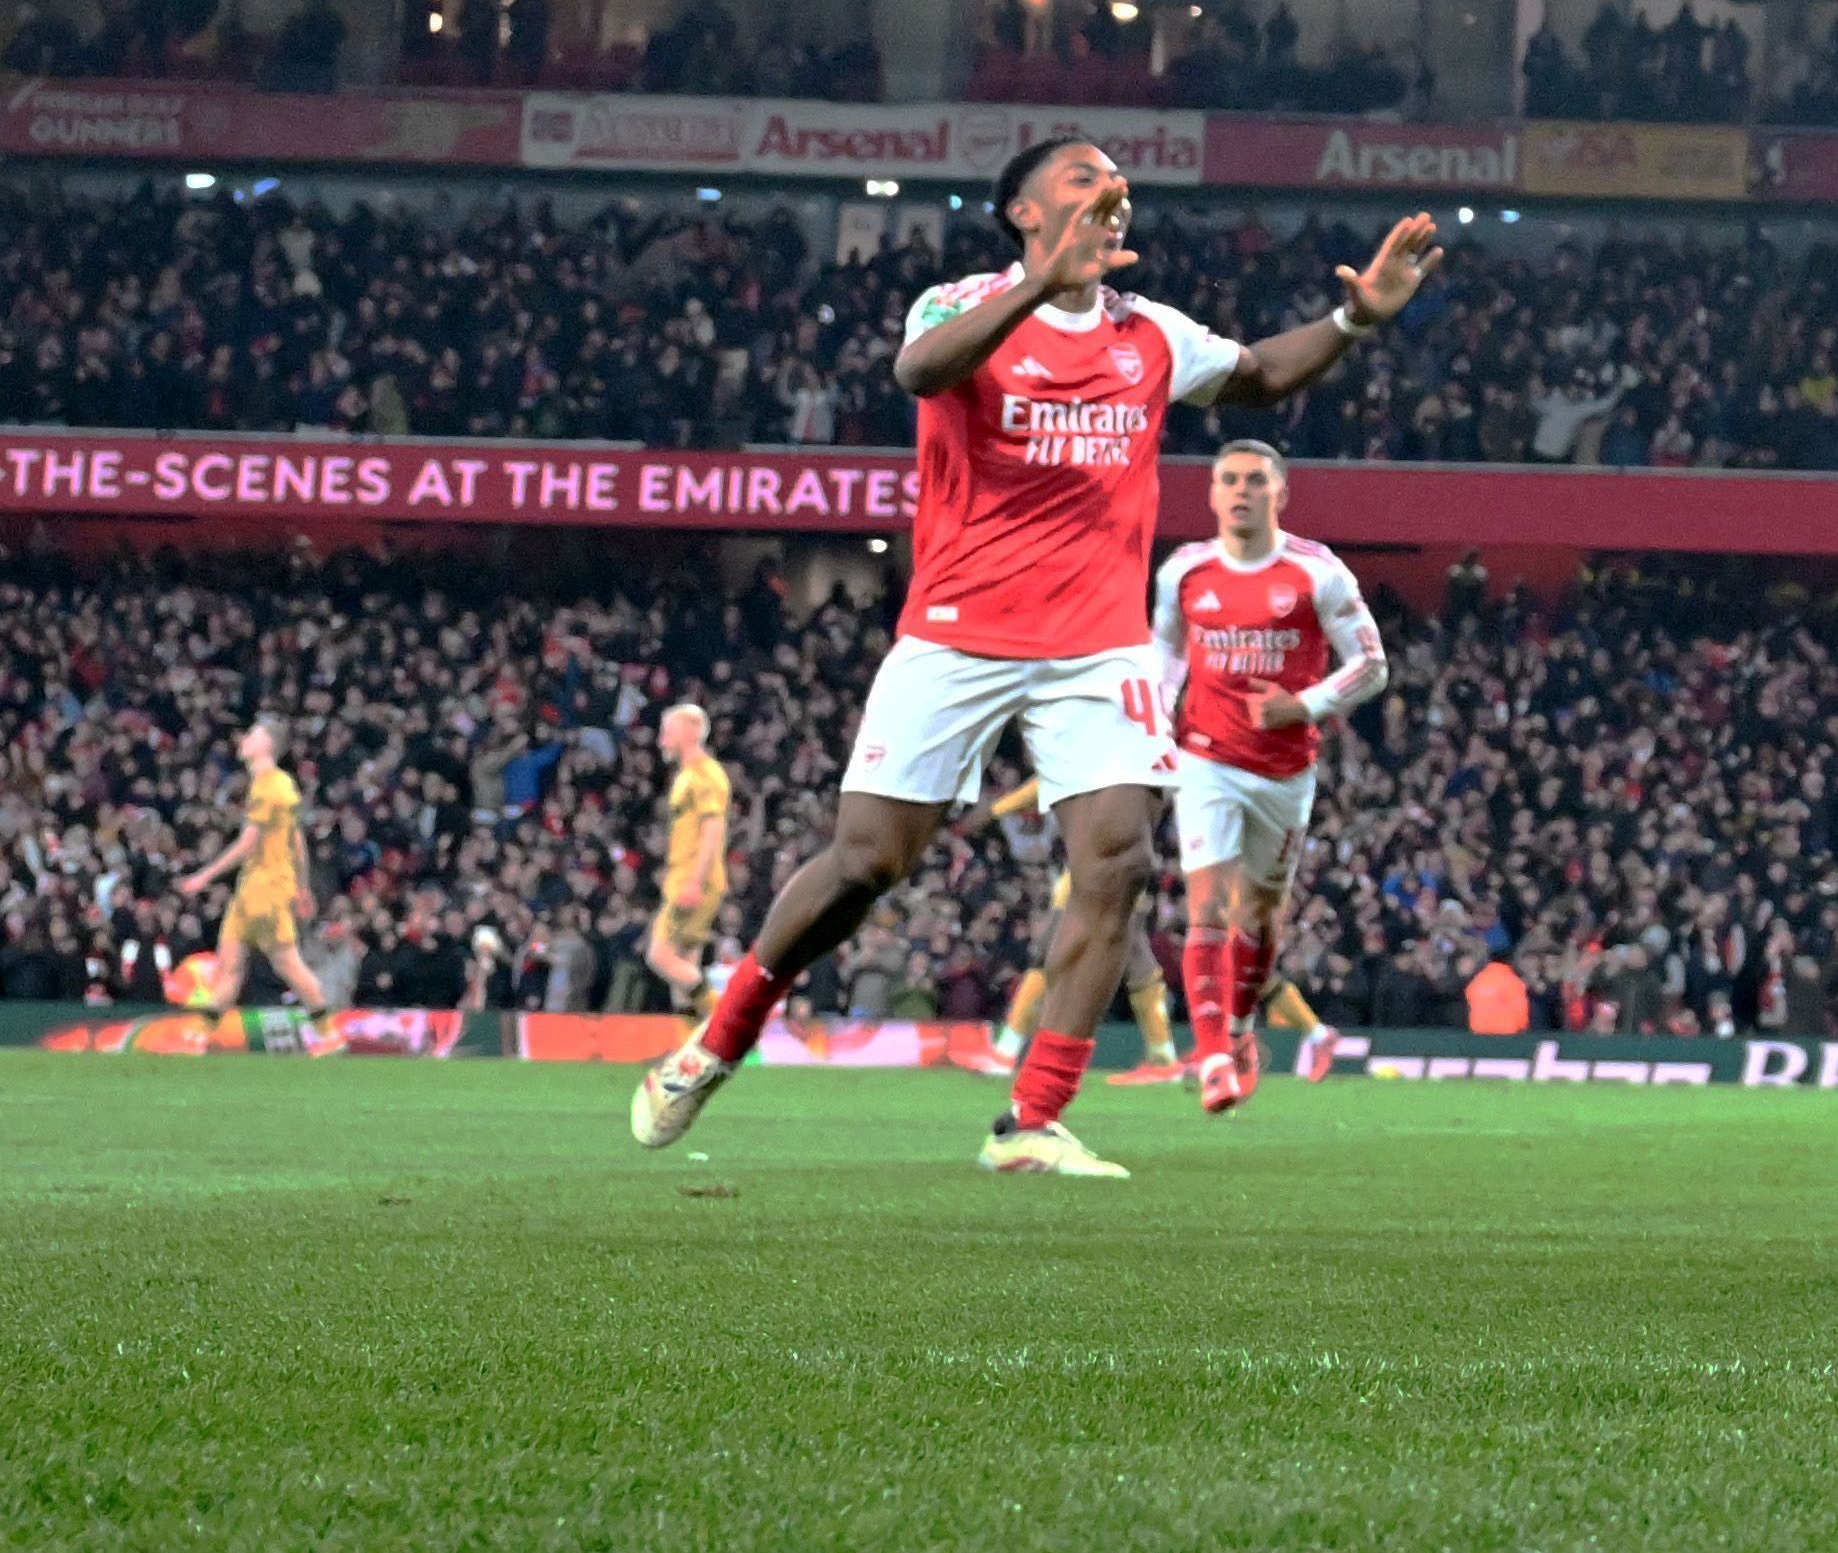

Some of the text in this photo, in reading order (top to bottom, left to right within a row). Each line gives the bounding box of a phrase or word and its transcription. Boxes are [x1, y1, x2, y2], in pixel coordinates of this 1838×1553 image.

[756, 115, 949, 163] Arsenal
[1316, 128, 1516, 184] Arsenal
[0, 447, 922, 518] THE-SCENES AT THE EMIRATES
